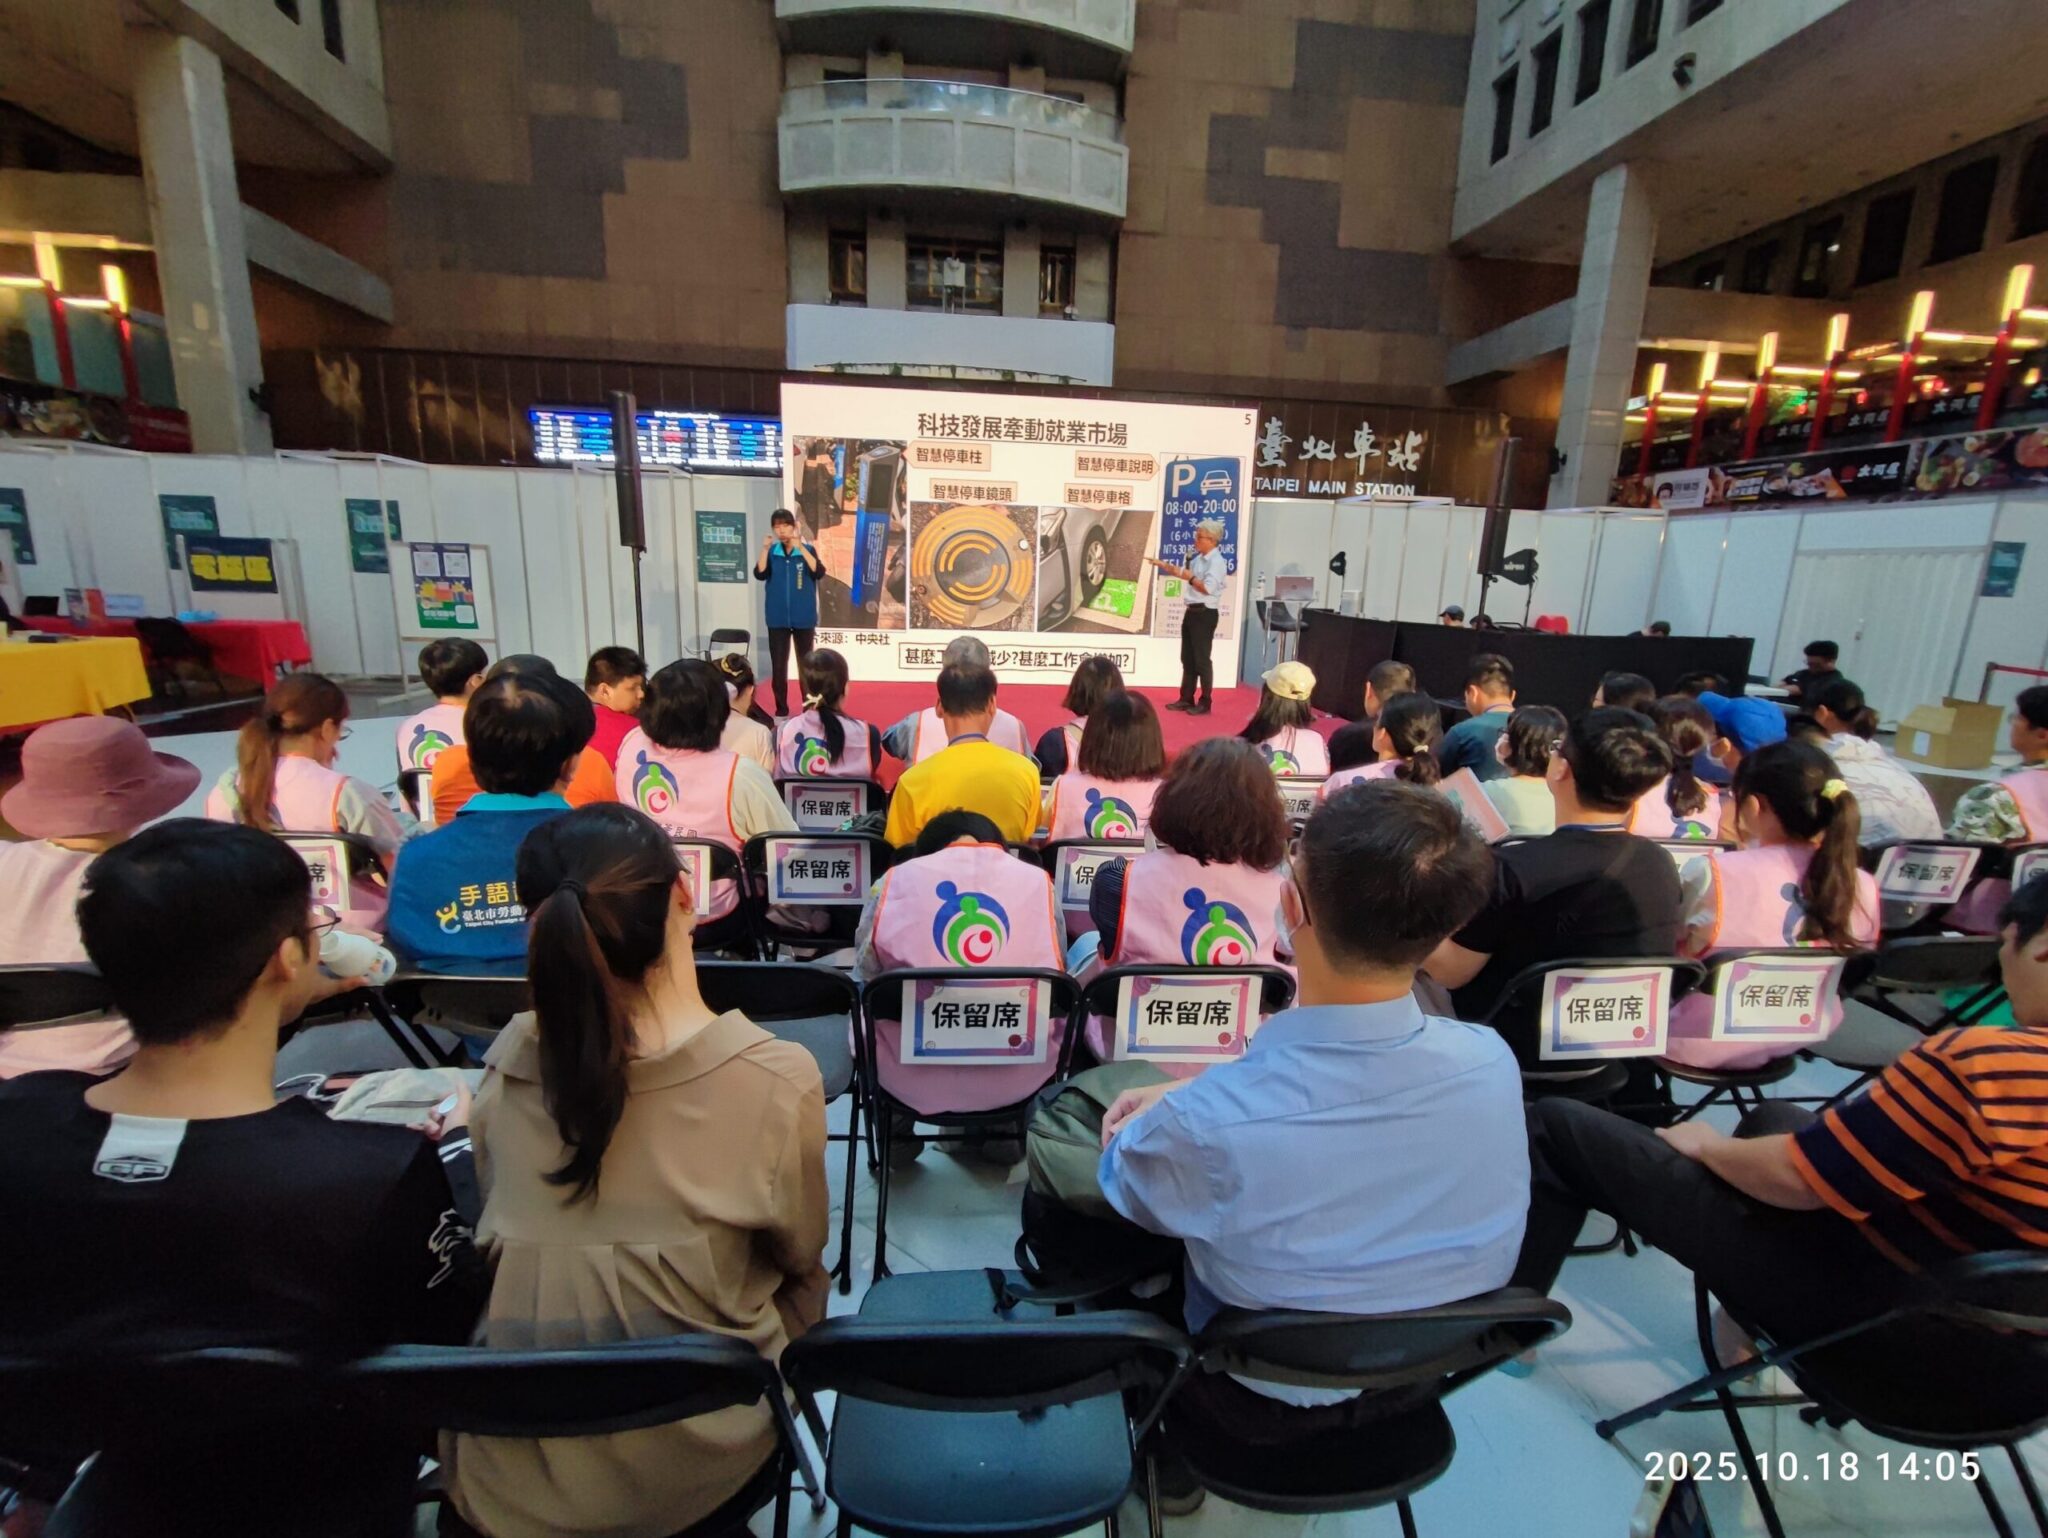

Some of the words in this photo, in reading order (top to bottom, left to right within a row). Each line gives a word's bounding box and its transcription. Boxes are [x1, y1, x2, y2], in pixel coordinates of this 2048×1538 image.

[918, 413, 1128, 446] 科技發展牽動就業市場
[1244, 414, 1251, 425] 5
[916, 447, 982, 465] 智慧停車柱
[1257, 416, 1422, 476] 臺北車站
[1077, 456, 1154, 475] 智慧停車說明
[933, 484, 1012, 502] 智慧停車鏡頭
[1067, 487, 1131, 505] 智慧停車格
[1255, 477, 1299, 492] TAIPEI
[1308, 481, 1346, 494] MAIN
[1355, 482, 1415, 497] STATION
[1165, 499, 1236, 515] 08:00-20:00
[801, 799, 851, 816] 保留席
[788, 859, 851, 880] 保留席
[1899, 862, 1955, 882] 保留席
[460, 882, 518, 906] 手語
[1739, 984, 1814, 1008] 保留席
[931, 1002, 1021, 1029] 保留席
[1145, 1000, 1232, 1027] 保留席
[1566, 994, 1644, 1025] 保留席
